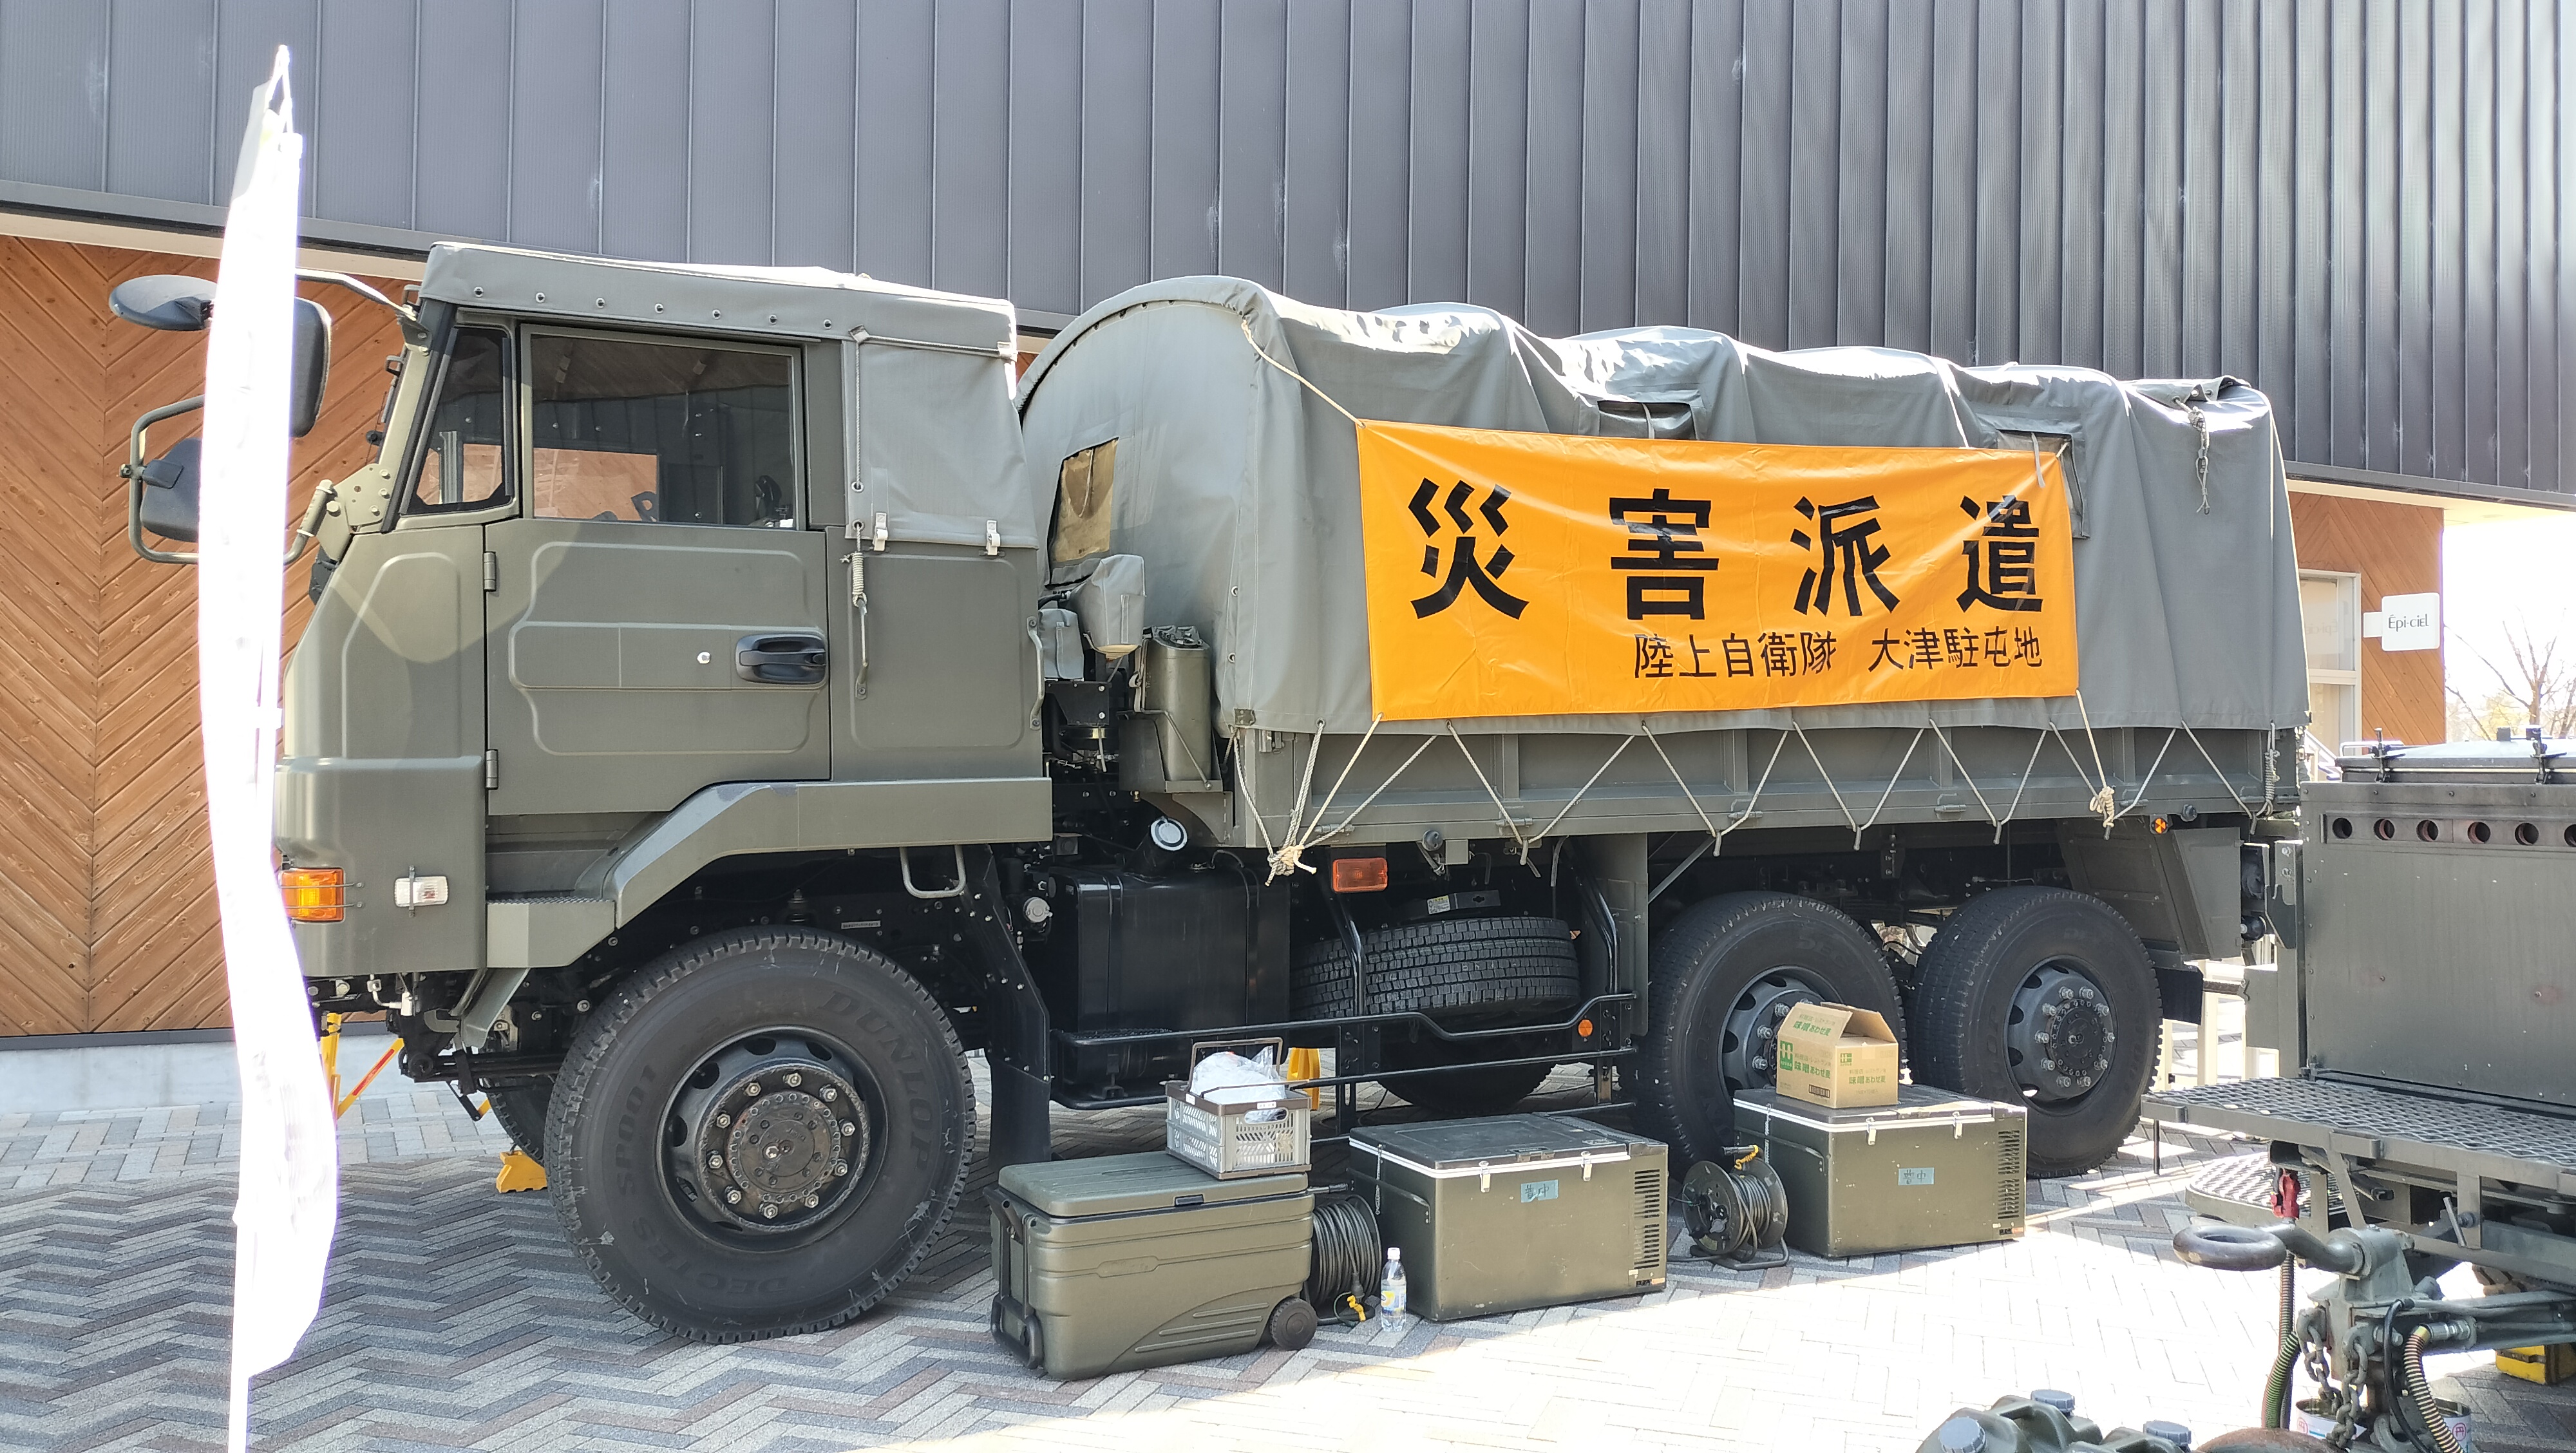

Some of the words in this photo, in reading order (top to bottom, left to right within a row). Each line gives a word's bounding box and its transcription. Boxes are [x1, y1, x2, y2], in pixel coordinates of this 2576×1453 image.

[1408, 478, 2042, 620] 災害派遣
[1635, 633, 1836, 678] 陸上自衛隊
[1869, 627, 2041, 670] 大津駐屯地
[818, 990, 934, 1168] DUNLOP
